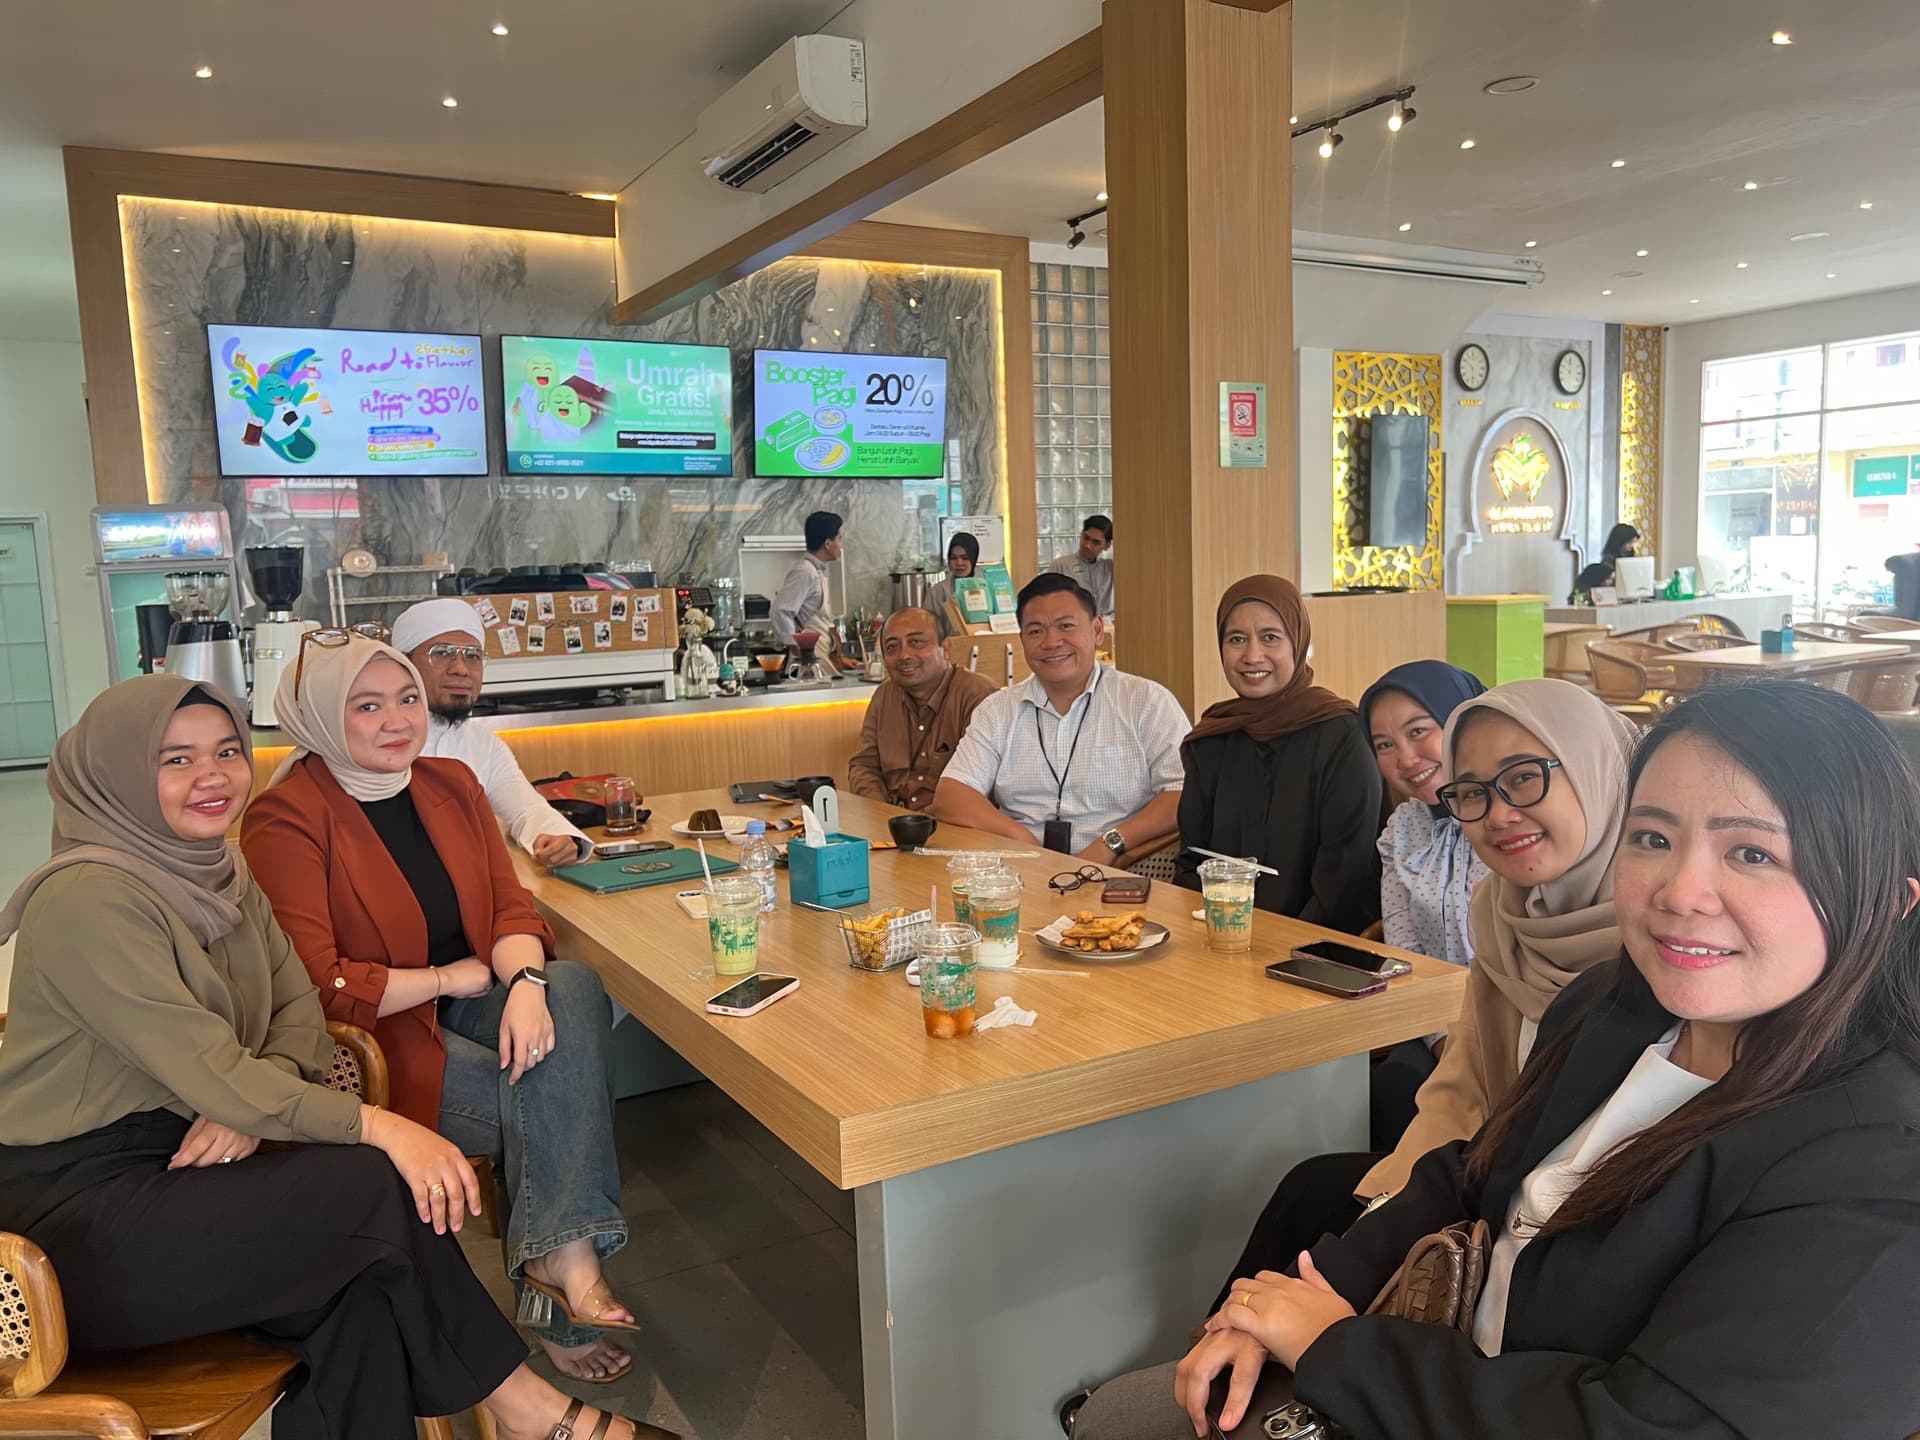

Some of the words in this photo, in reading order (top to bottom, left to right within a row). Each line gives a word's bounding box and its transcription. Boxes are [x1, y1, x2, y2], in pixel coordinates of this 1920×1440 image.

[341, 347, 397, 374] Road
[626, 358, 714, 386] Umrah
[766, 361, 847, 385] Booster
[417, 384, 479, 415] 35%
[638, 384, 712, 408] Gratis!
[865, 373, 935, 407] 20%
